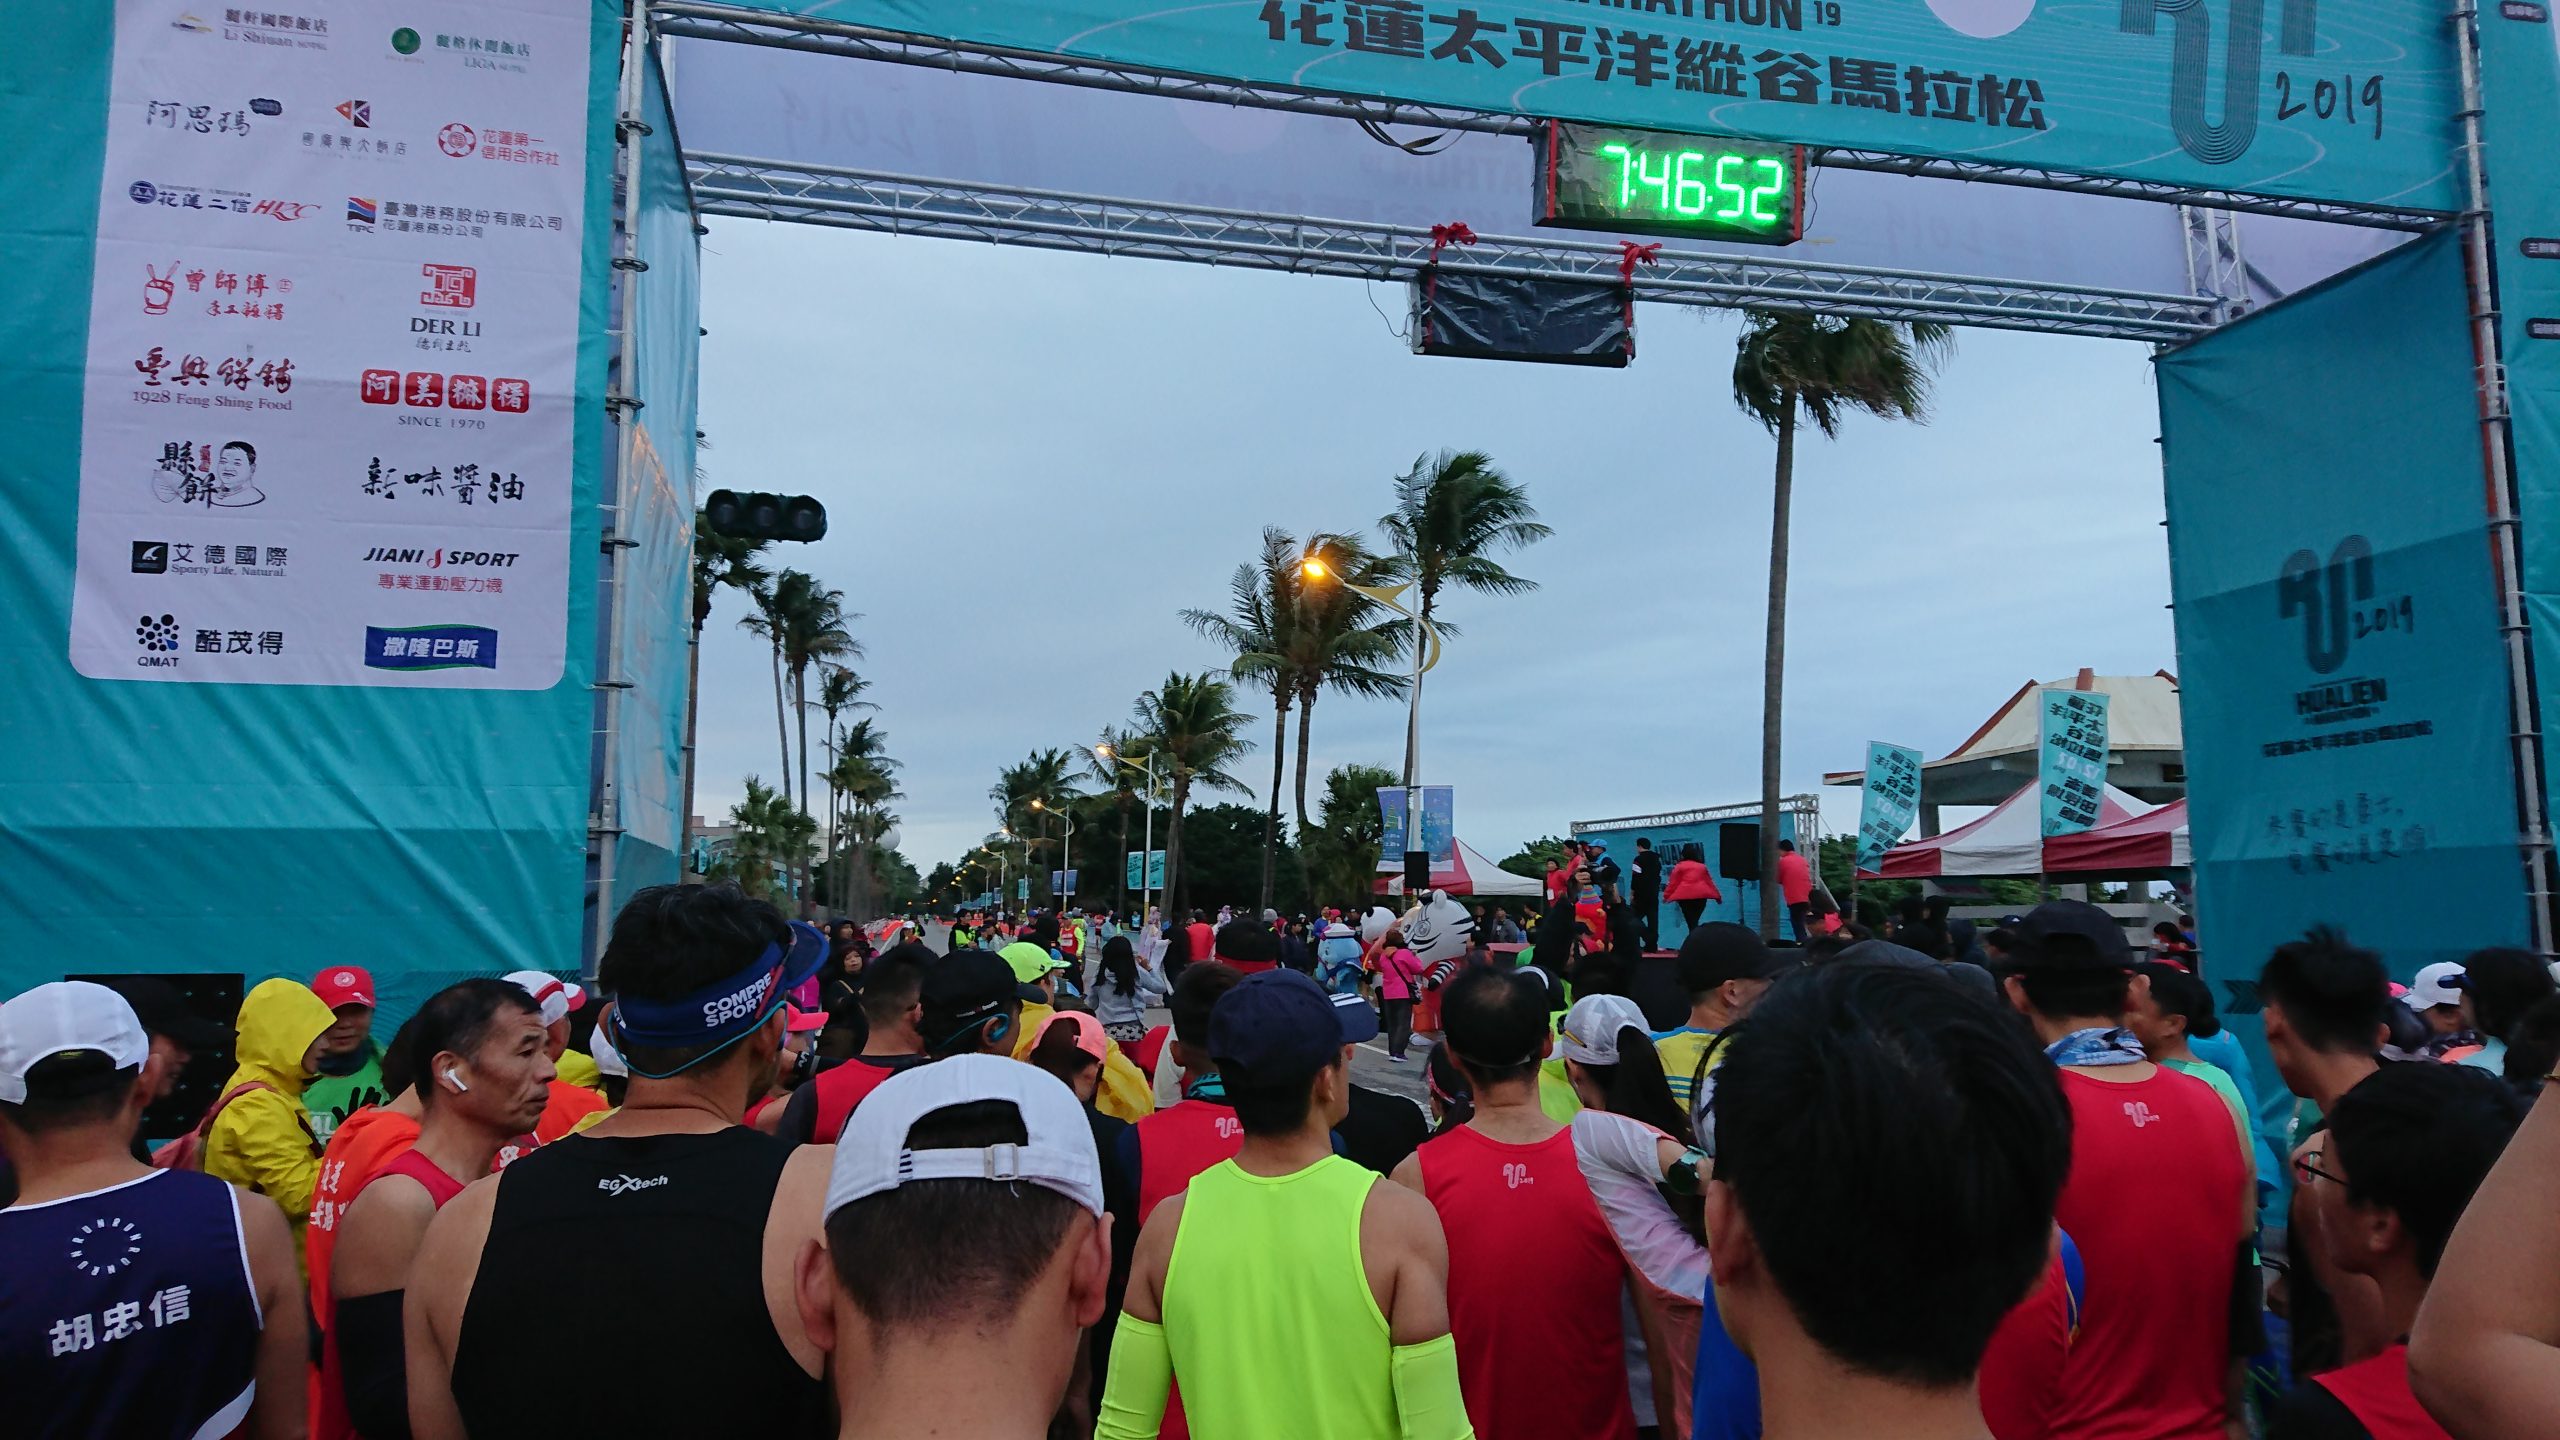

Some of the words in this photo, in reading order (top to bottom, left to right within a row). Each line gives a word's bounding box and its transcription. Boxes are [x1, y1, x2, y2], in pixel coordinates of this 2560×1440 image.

[2275, 70, 2385, 140] 2019
[481, 129, 544, 147] 花蓮第一
[481, 145, 560, 166] 信用合作社
[157, 191, 252, 213] 花蓮二信
[186, 268, 269, 297] 曾師傅
[410, 317, 456, 335] DER
[462, 321, 481, 337] LI
[133, 390, 171, 404] 1928
[176, 392, 210, 408] Feng
[214, 395, 254, 412] Shing
[258, 397, 293, 411] Food
[398, 415, 442, 428] SINCE
[450, 418, 486, 430] 1970
[172, 543, 288, 567] 艾德國際
[363, 547, 424, 563] JIANI
[447, 551, 520, 568] SPORT
[171, 563, 210, 577] Sporty
[378, 573, 503, 594] 專業運動壓力襪
[2352, 595, 2414, 639] 2019
[194, 629, 284, 656] 酷茂得
[383, 636, 480, 659] 撒隆巴斯
[137, 656, 180, 668] QMAT
[705, 991, 765, 1028] SPORT
[49, 1284, 191, 1357] 胡忠信
